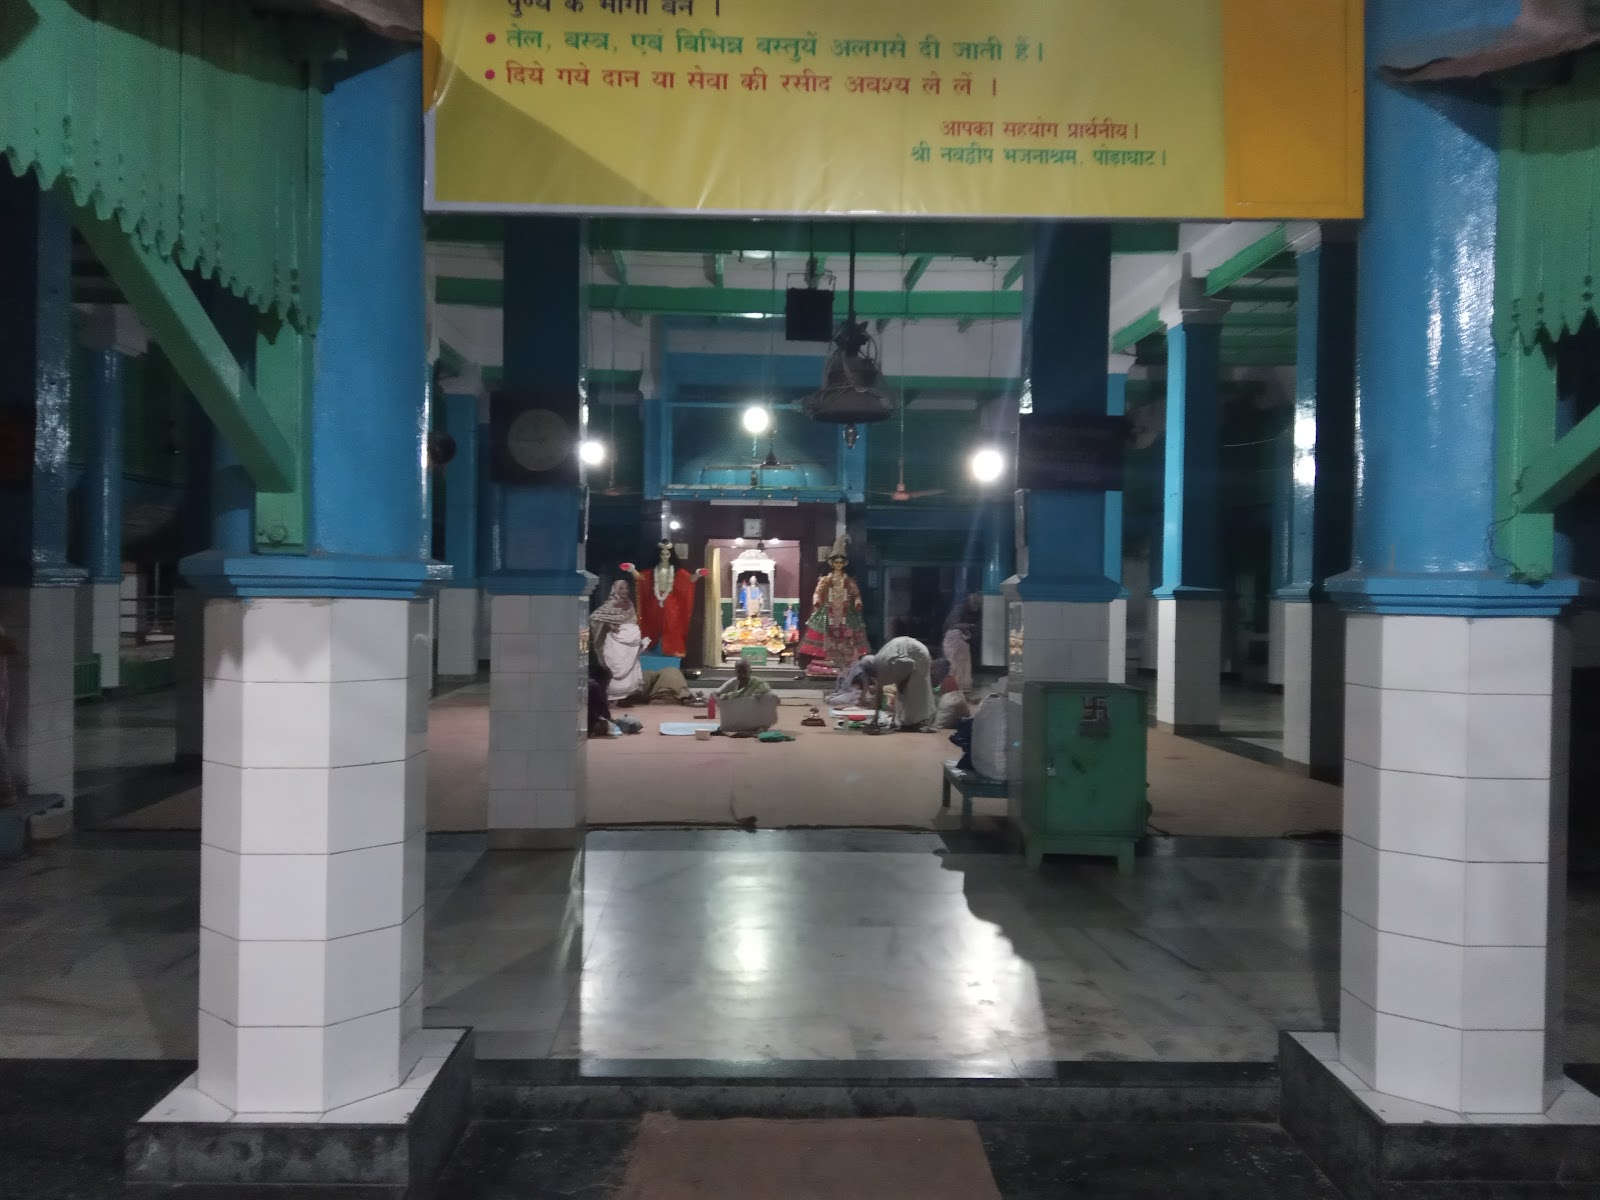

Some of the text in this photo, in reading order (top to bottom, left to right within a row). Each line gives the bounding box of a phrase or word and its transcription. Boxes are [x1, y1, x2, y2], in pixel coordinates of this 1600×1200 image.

[919, 34, 941, 60] दी
[952, 36, 1004, 61] जाती
[506, 60, 545, 86] दिये
[556, 61, 591, 87] गये
[602, 70, 640, 88] दान
[652, 71, 676, 90] या
[687, 65, 729, 91] सेवा
[740, 66, 769, 92] की
[779, 66, 833, 93] रसीद
[846, 74, 911, 95] अवश्य
[941, 120, 995, 138] आपका
[1003, 115, 1060, 139] सहयोग
[911, 140, 932, 164] श्री
